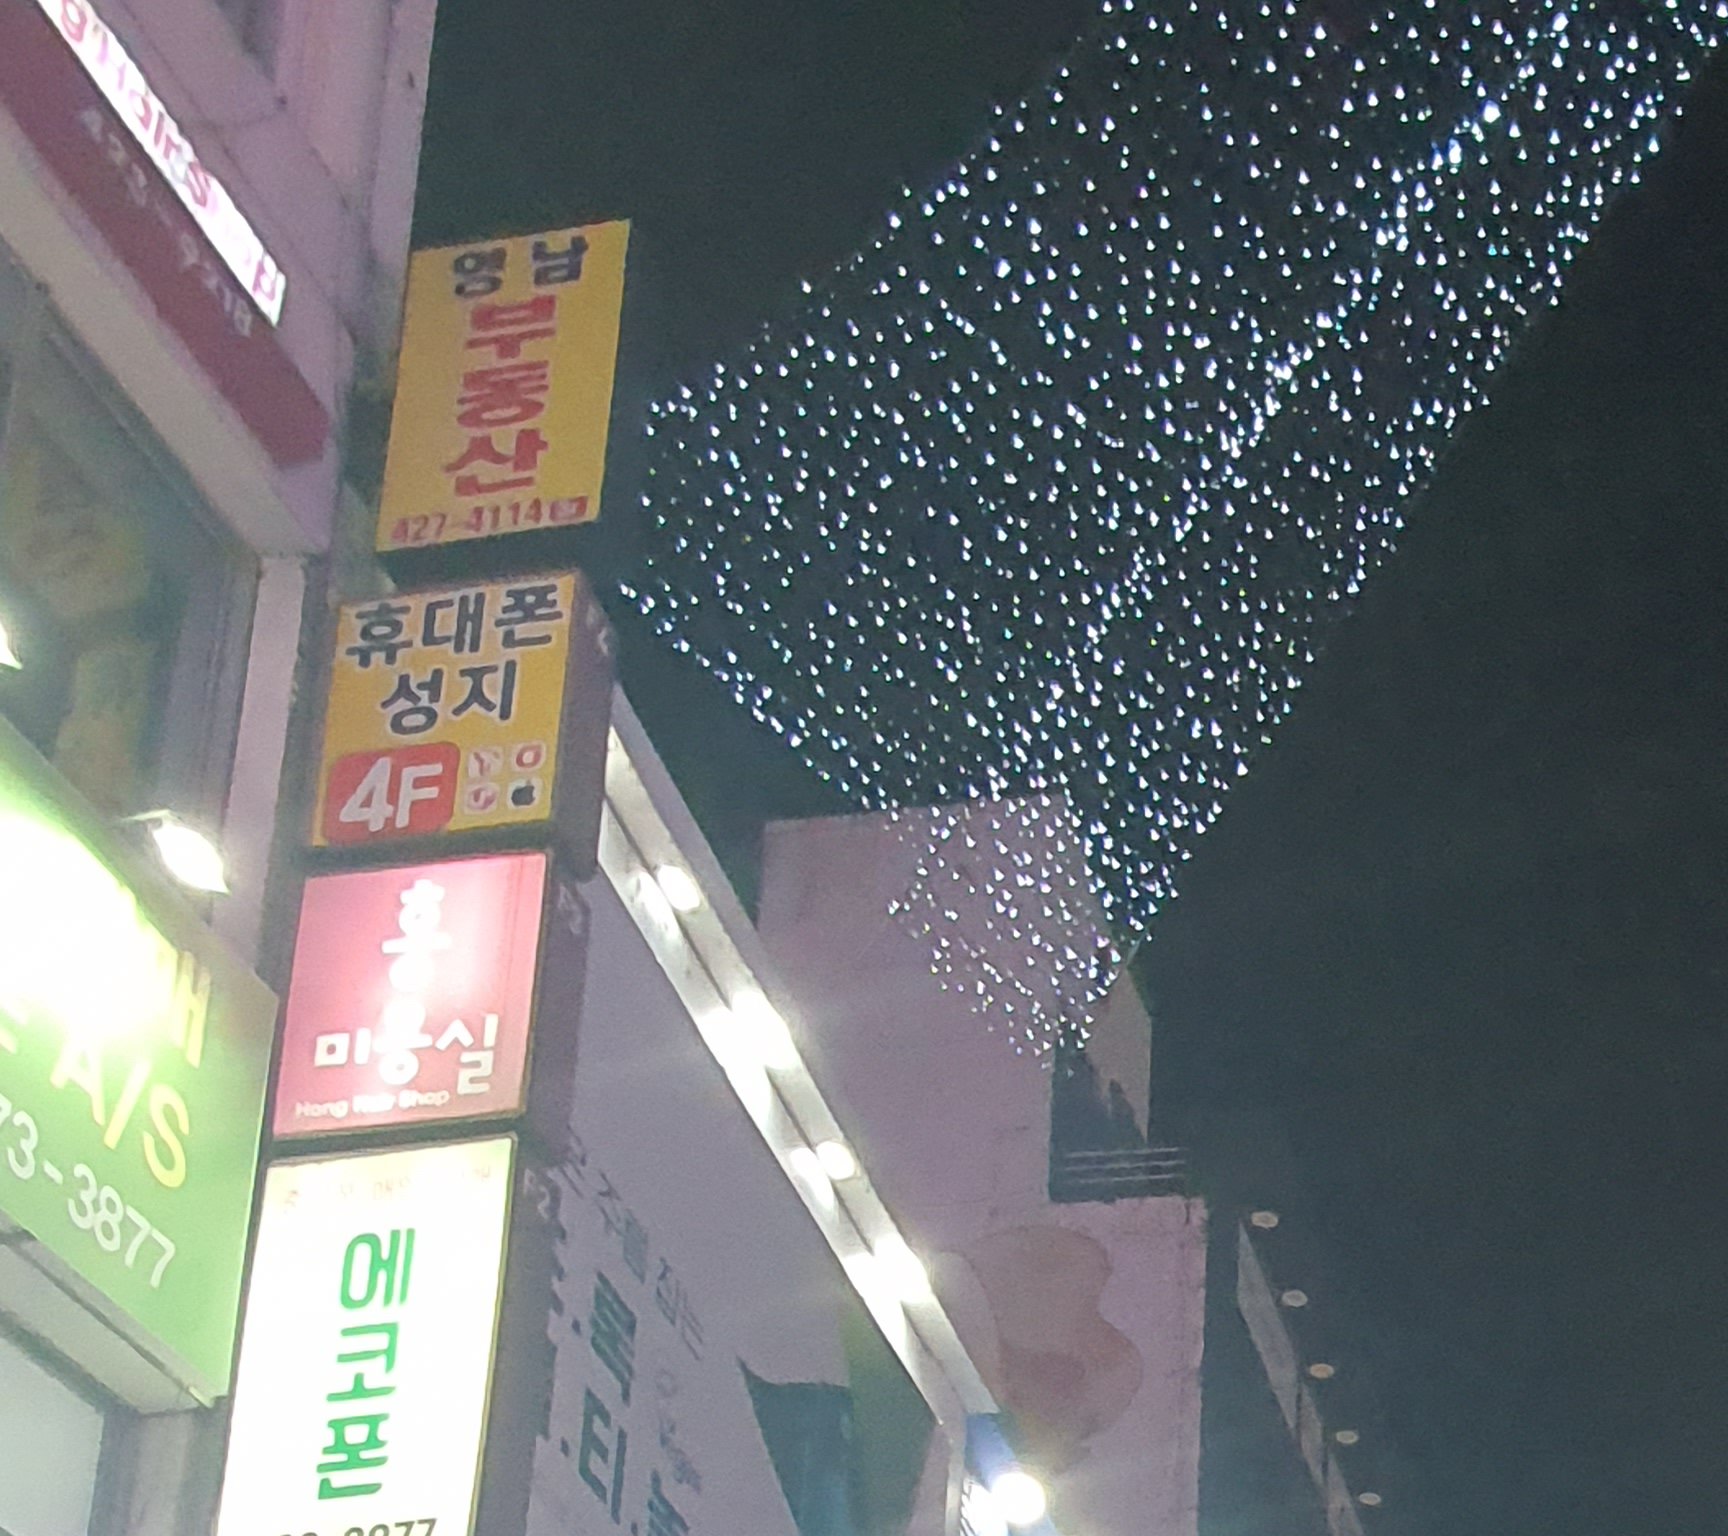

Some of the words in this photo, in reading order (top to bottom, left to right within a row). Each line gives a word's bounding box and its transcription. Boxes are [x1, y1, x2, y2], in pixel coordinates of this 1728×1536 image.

[454, 236, 588, 298] 영남
[444, 295, 555, 497] 부동산
[346, 584, 563, 668] 휴대폰
[381, 659, 517, 735] 성지
[339, 757, 443, 832] 4F
[314, 1000, 499, 1096] 미용실
[0, 1094, 176, 1290] 3-3877
[316, 1227, 416, 1500] 에코폰
